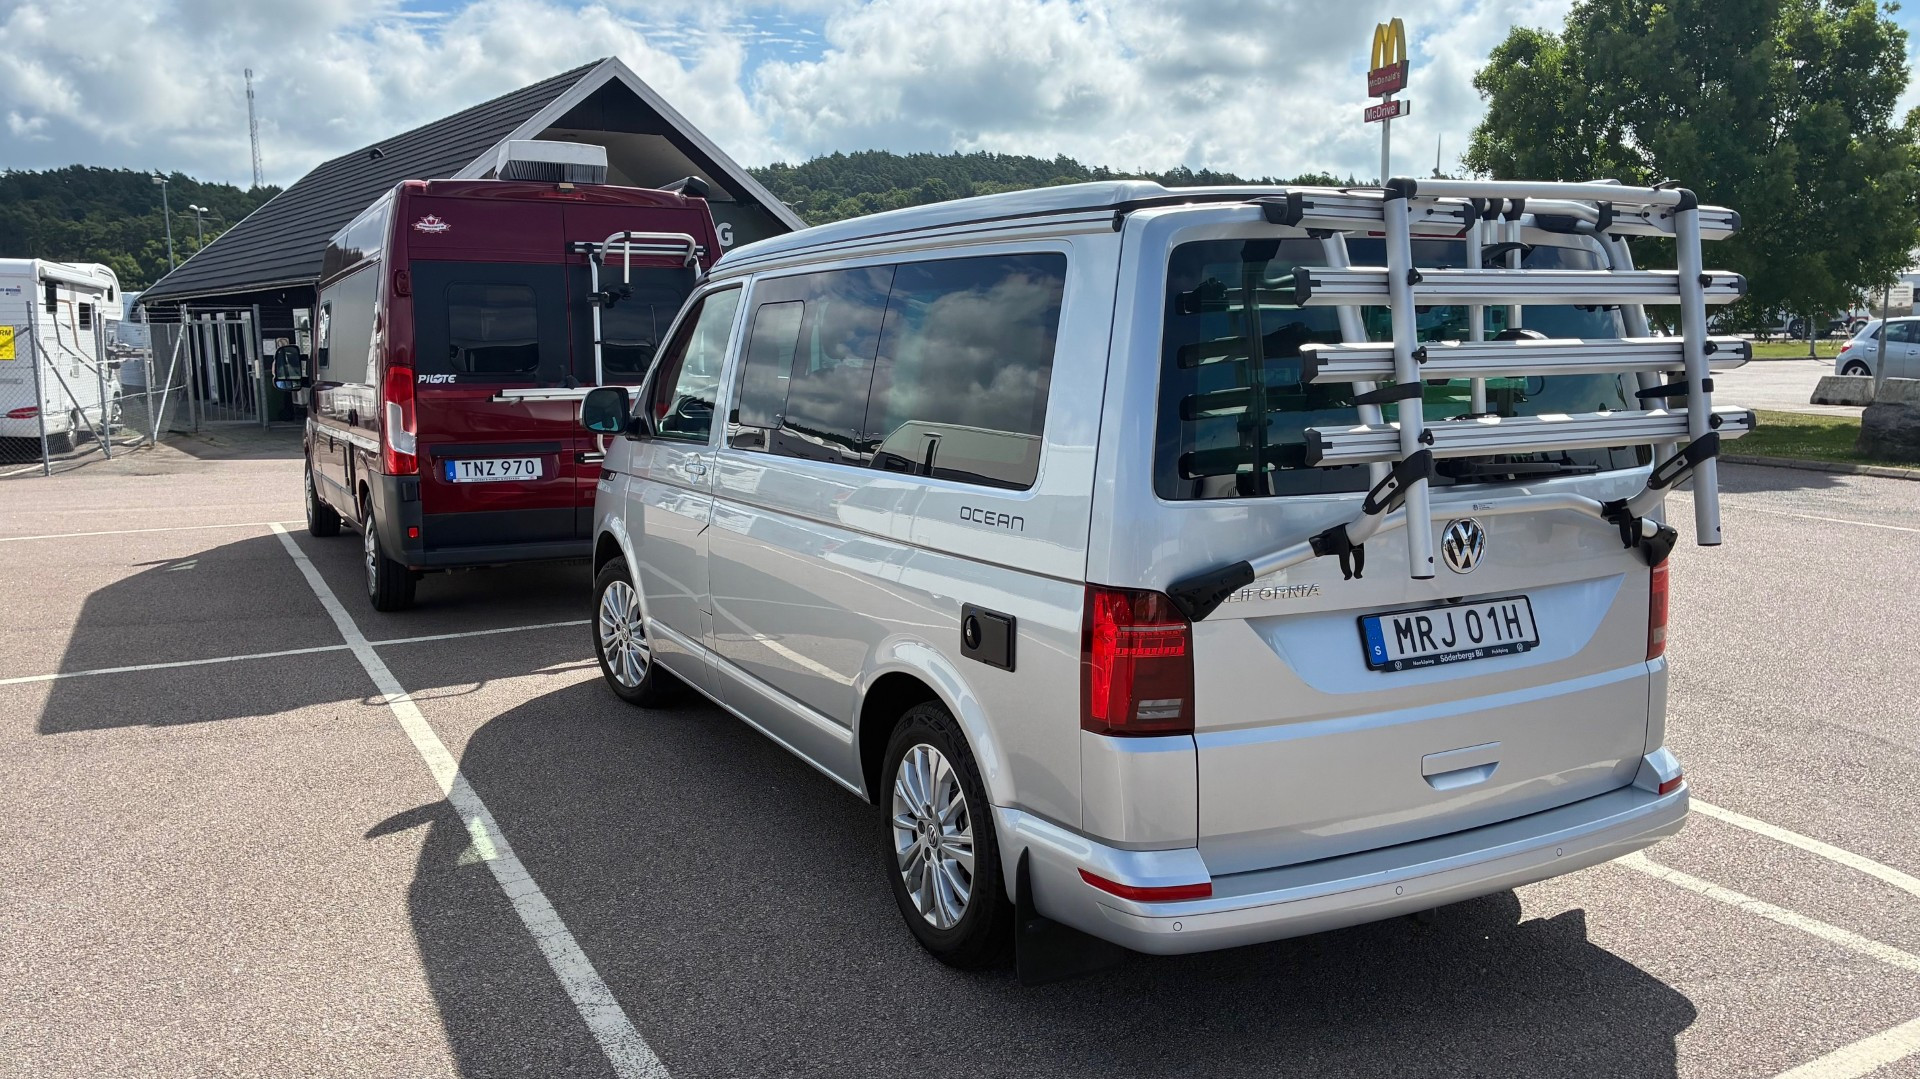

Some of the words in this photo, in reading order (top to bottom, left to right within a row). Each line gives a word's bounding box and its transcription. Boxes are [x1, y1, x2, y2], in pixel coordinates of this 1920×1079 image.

[1369, 71, 1401, 87] McDonald's
[1365, 104, 1396, 121] McDrive
[417, 374, 457, 384] PILOTE
[461, 460, 496, 477] TNZ
[500, 460, 535, 476] 970
[960, 506, 1024, 531] OCEAN
[1222, 583, 1320, 603] LIFORNIA
[1393, 612, 1457, 655] MRJ
[1464, 603, 1524, 644] 01H
[1374, 645, 1382, 656] S
[1440, 650, 1475, 663] Söderbergs
[1475, 648, 1484, 658] Bil
